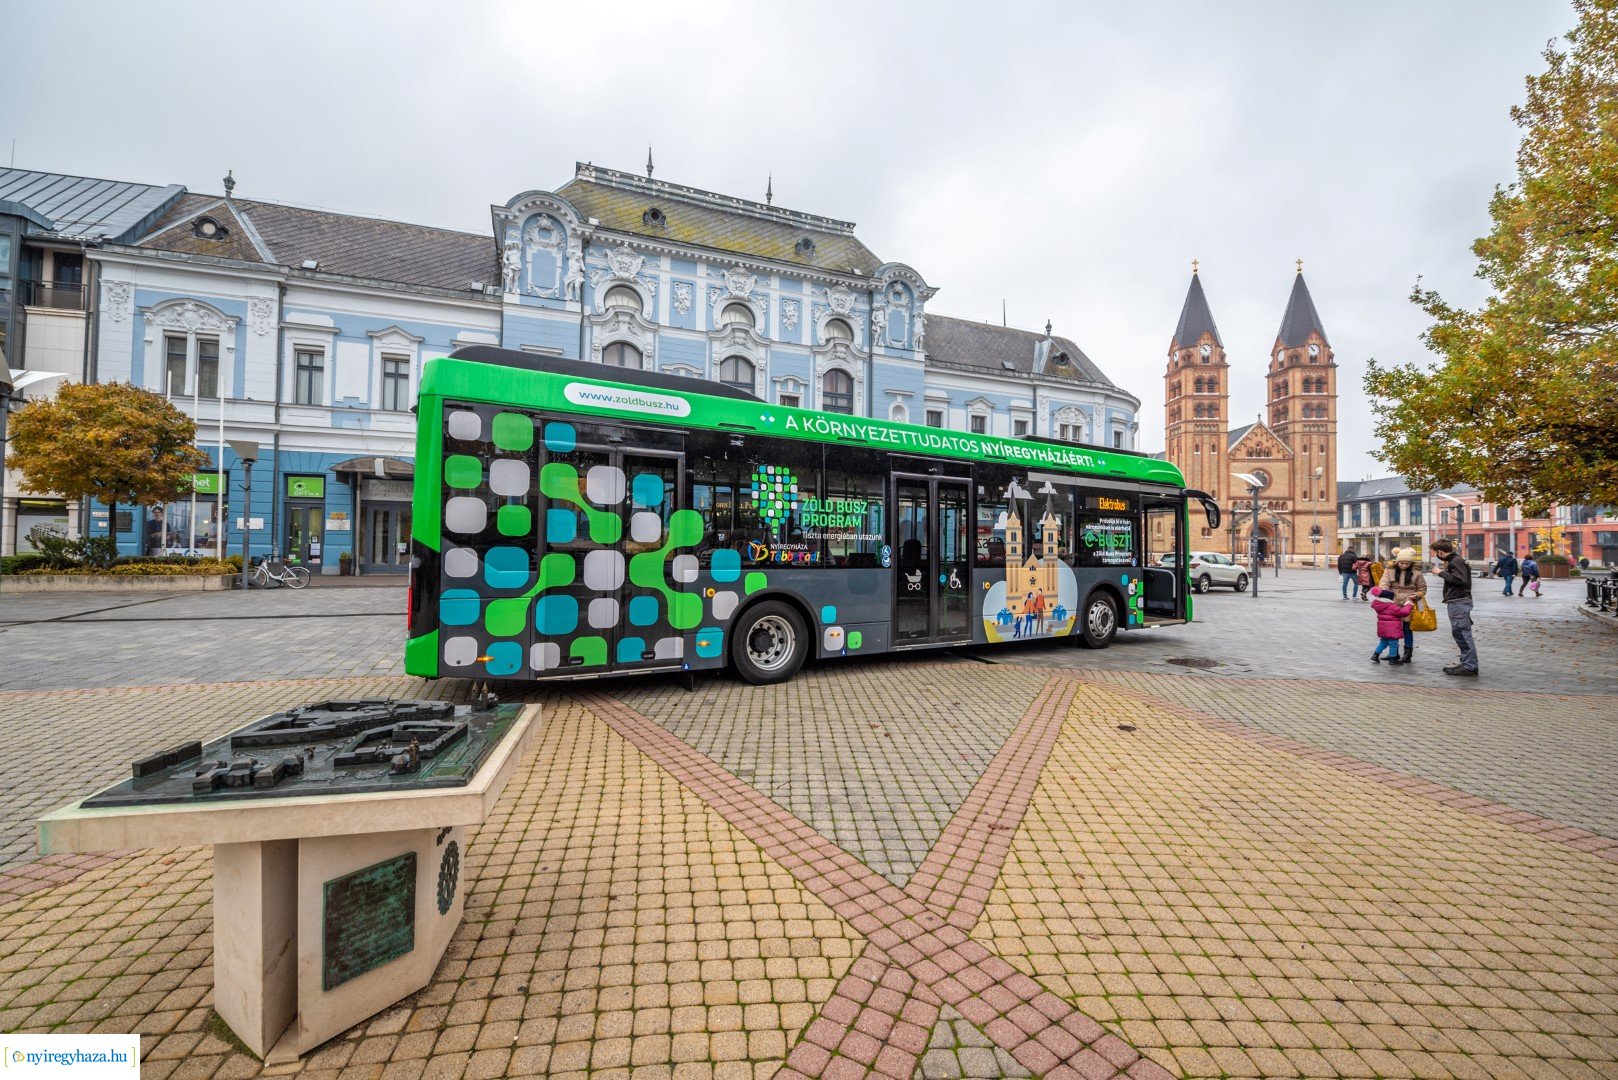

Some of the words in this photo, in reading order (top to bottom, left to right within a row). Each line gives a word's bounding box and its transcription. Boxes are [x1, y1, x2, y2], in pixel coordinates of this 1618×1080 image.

[578, 390, 679, 411] www.zoldbusz.hu
[785, 415, 799, 430] A
[802, 415, 979, 453] KÖRNYEZETTUDATOS
[981, 441, 1095, 467] NYÍREGYHÁZÁÉRT!
[801, 496, 834, 513] ZÖLD
[836, 501, 868, 514] BUSZ
[1099, 497, 1126, 511] Elektrobus
[802, 514, 862, 528] PROGRAM
[801, 531, 822, 539] Tiszta
[822, 532, 857, 541] energiában
[858, 533, 883, 541] utazunk
